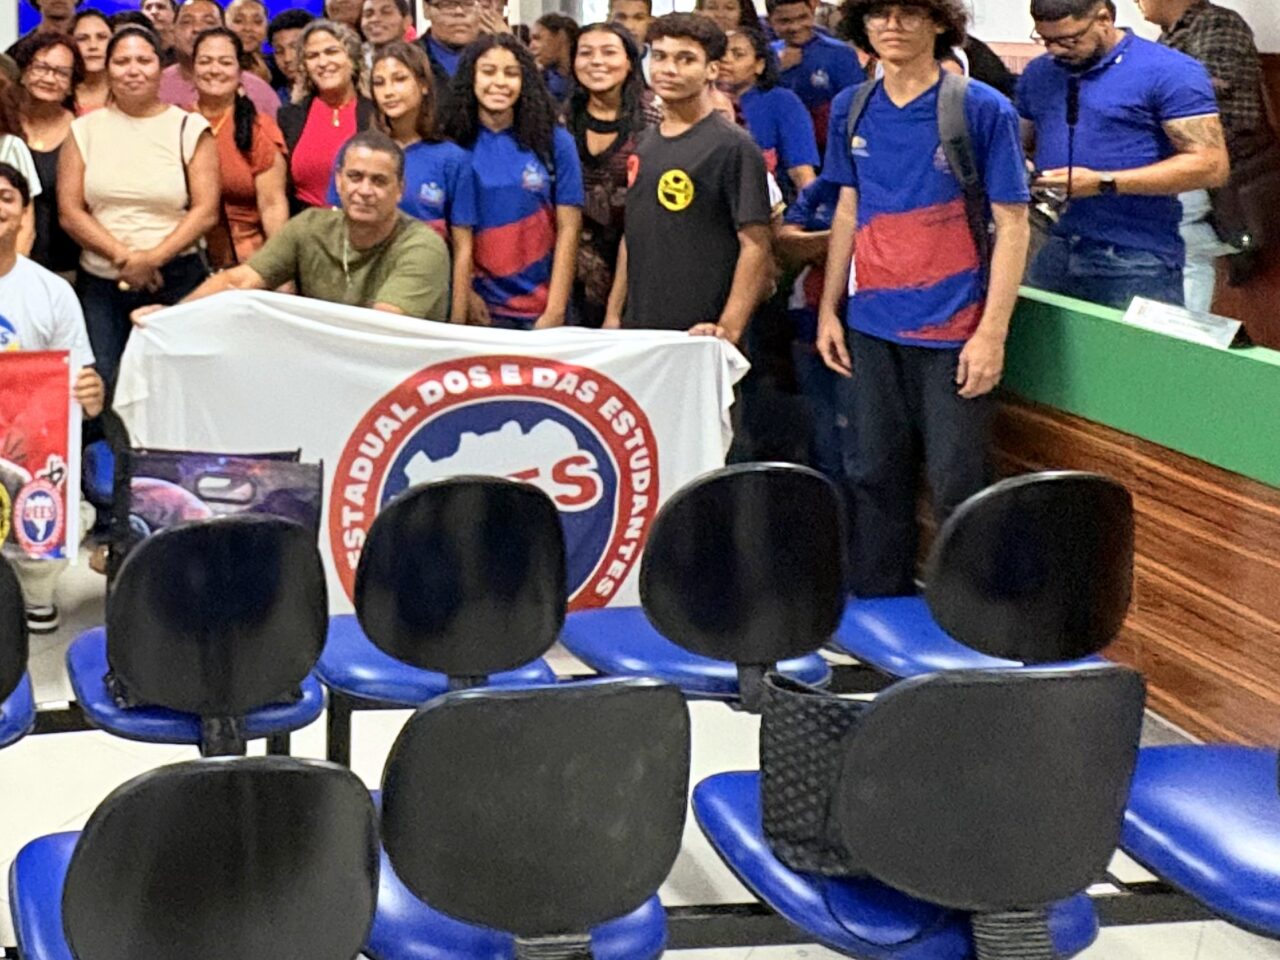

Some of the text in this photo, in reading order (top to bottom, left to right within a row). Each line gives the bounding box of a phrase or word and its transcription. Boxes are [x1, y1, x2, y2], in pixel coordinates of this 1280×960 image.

[417, 365, 493, 407] DOS
[499, 363, 523, 386] E
[532, 366, 599, 404] DAS
[596, 395, 652, 598] ESTUDANTES
